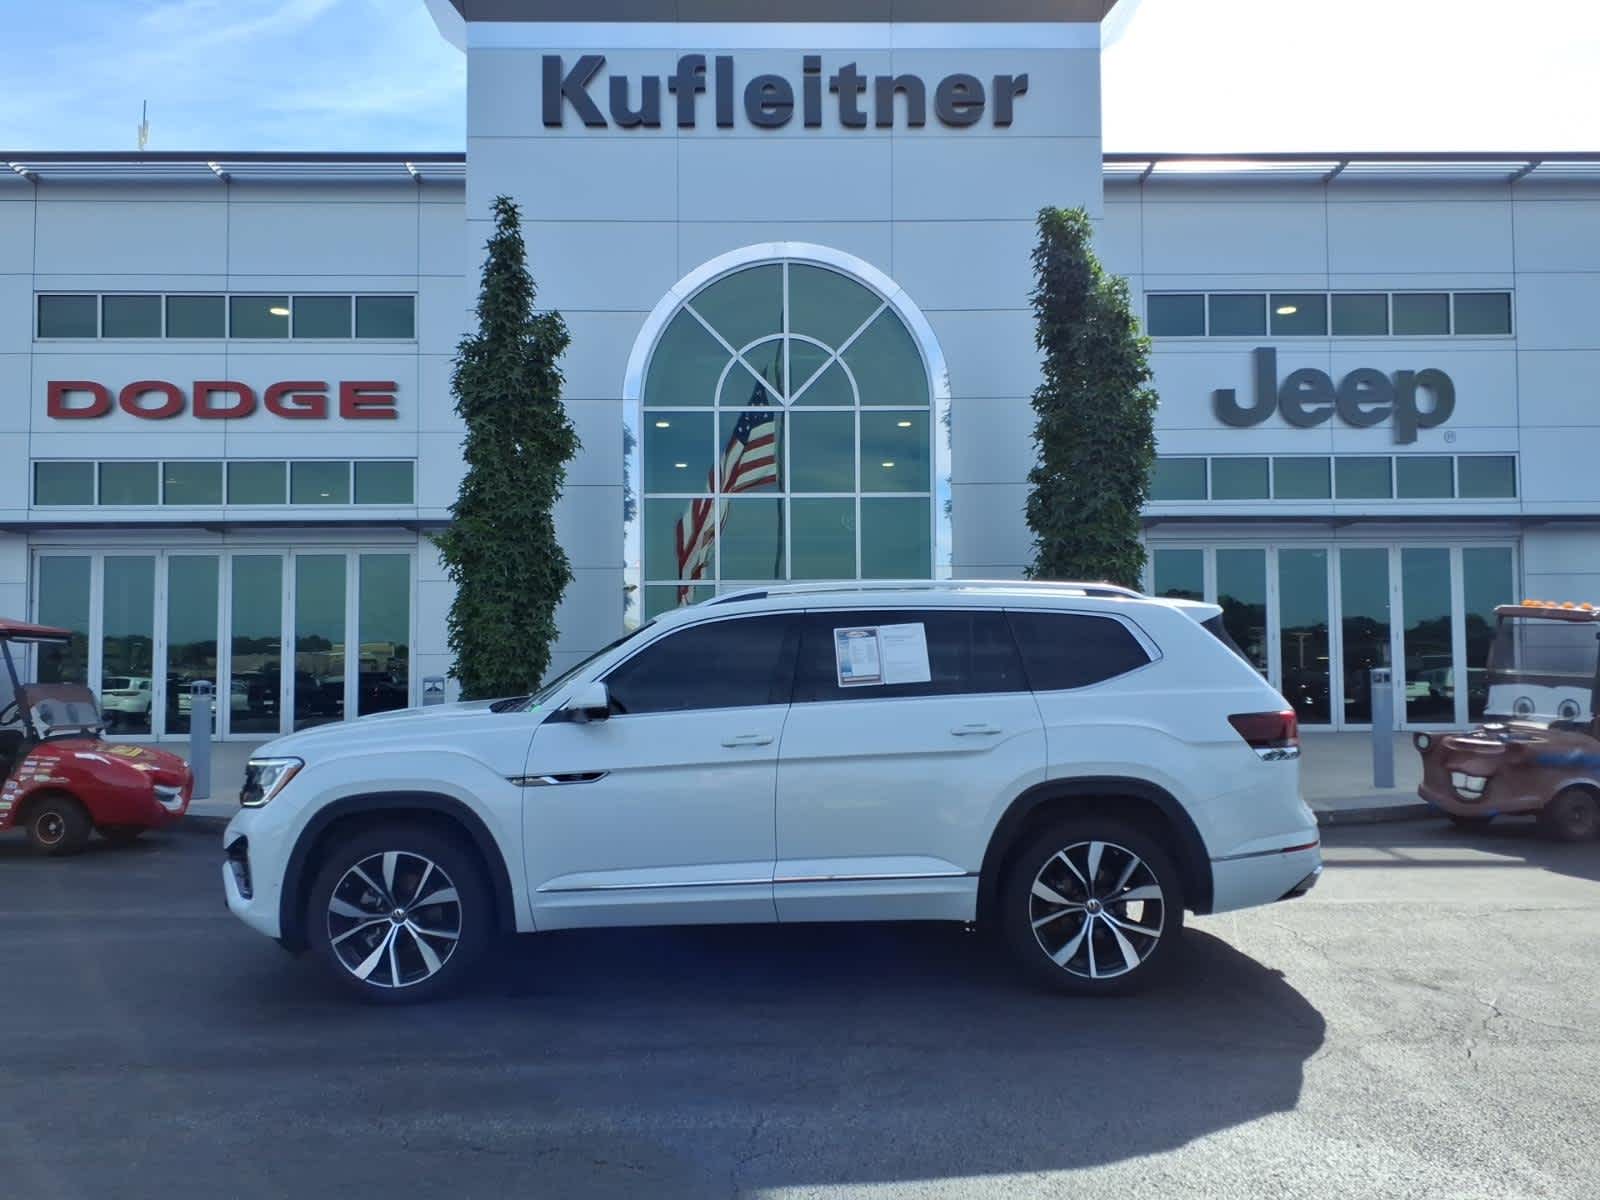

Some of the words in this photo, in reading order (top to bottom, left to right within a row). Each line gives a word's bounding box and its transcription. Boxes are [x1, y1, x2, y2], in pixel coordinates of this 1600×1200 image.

[542, 54, 1029, 128] Kufleitner
[47, 380, 399, 419] DODGE
[1213, 346, 1456, 444] Jeep
